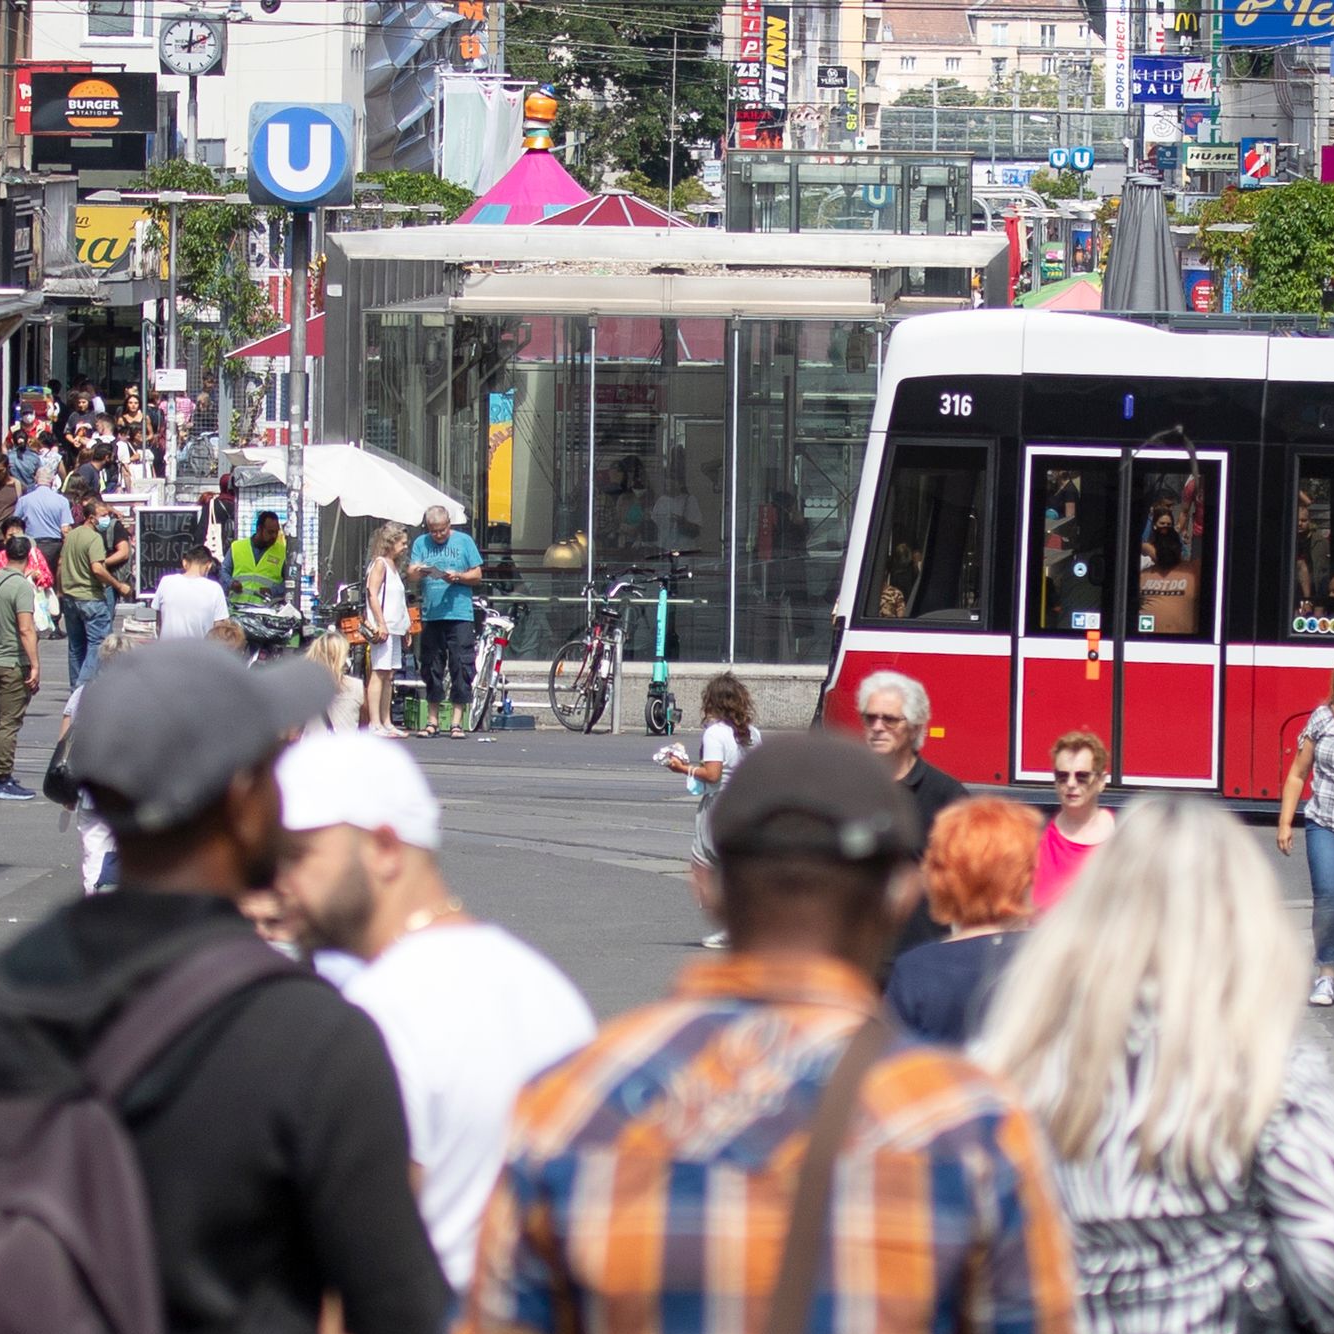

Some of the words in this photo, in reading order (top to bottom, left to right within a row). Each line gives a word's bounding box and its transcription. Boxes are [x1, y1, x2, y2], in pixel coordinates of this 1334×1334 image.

[68, 99, 120, 110] BURGER
[267, 123, 332, 193] U
[939, 393, 973, 417] 316
[1141, 578, 1169, 591] JUST
[1170, 578, 1189, 591] DO
